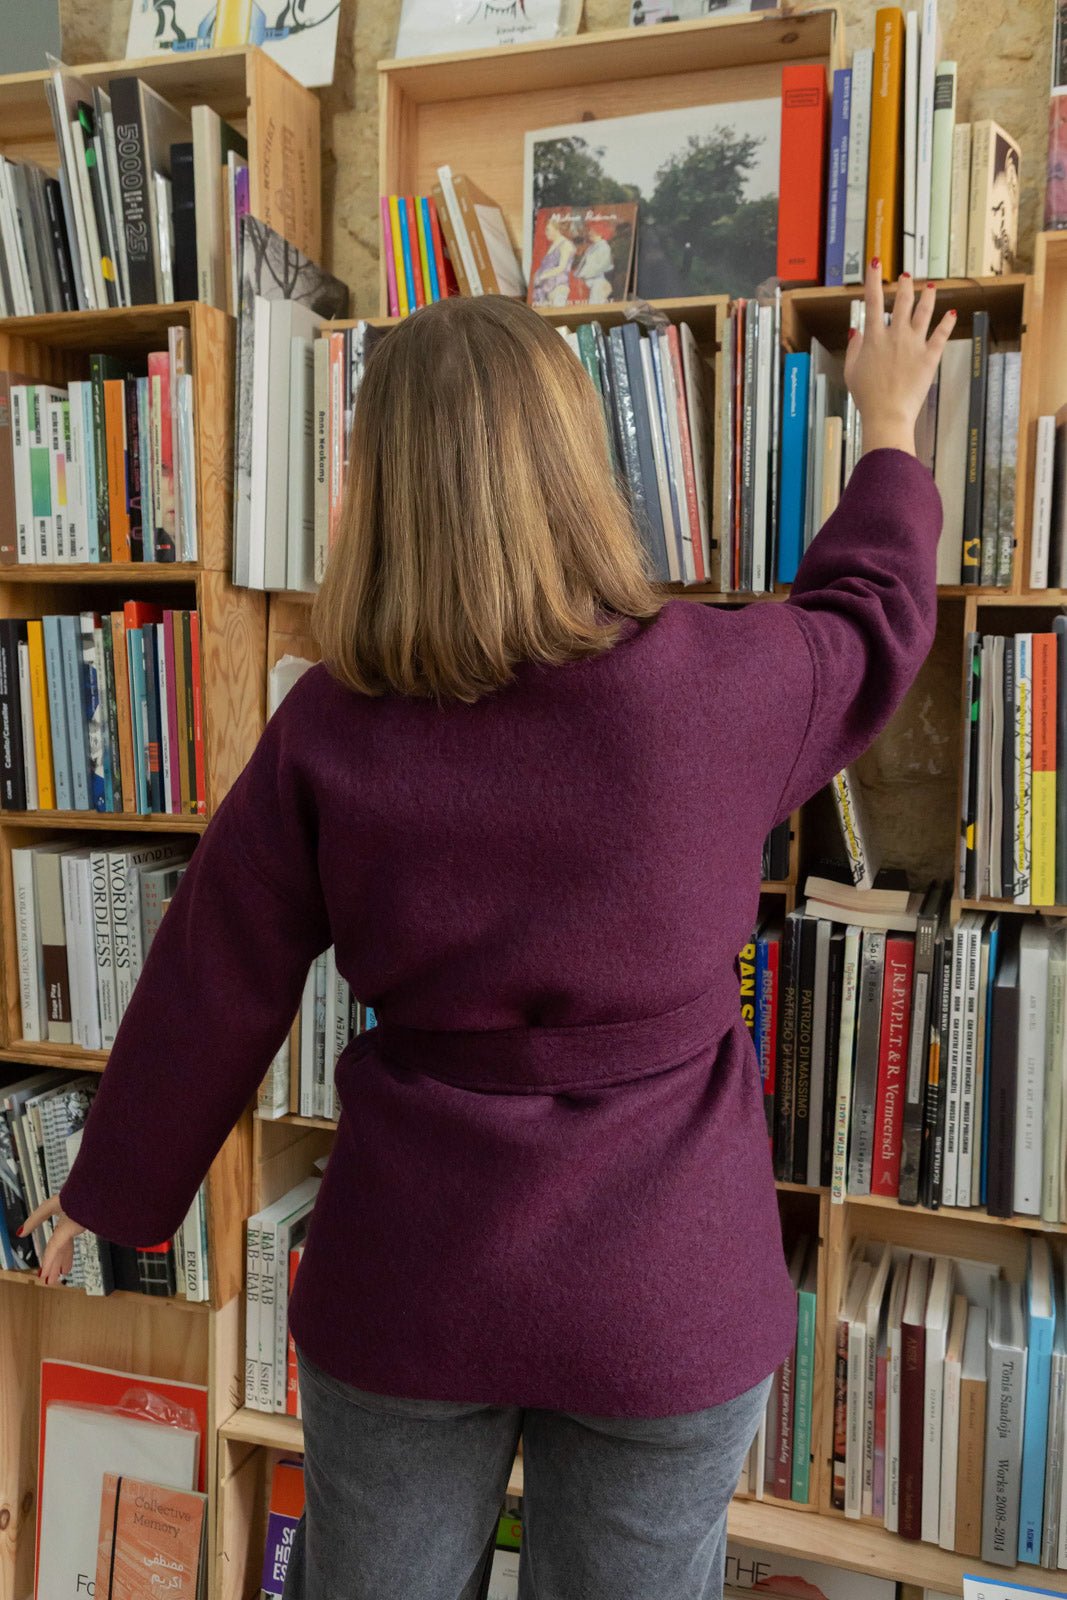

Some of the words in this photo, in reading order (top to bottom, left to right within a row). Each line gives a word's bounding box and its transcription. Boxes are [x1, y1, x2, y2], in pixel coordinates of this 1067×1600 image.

[317, 438, 326, 484] Neukamp
[92, 858, 111, 968] WORDLESS
[111, 858, 130, 968] WORDLESS
[868, 943, 879, 975] Spiral
[955, 957, 963, 990] ANDRIESSEN
[50, 984, 58, 998] Play
[763, 969, 773, 1001] ROSE
[868, 981, 876, 1002] Book
[942, 964, 950, 1012] GERSTBERGER
[51, 999, 59, 1020] Stage
[783, 986, 795, 1040] PATRIZIO
[800, 989, 812, 1043] PATRIZIO
[888, 960, 907, 1047] J.R.P.V.P.L.T.
[1029, 994, 1037, 1009] ANN
[760, 1003, 773, 1079] FINN-KELCEY
[782, 1043, 793, 1055] DI
[799, 1046, 810, 1057] DI
[952, 1030, 960, 1049] CENTRE
[966, 1031, 974, 1050] CENTRE
[887, 1065, 901, 1079] R.
[888, 1050, 900, 1062] &
[781, 1058, 793, 1116] MASSIMO
[797, 1061, 810, 1118] MASSIMO
[860, 1109, 868, 1126] Ann
[882, 1084, 899, 1160] Vermeersch
[949, 1100, 957, 1121] MOUSSE
[963, 1101, 971, 1122] MOUSSE
[948, 1122, 956, 1153] PUBLISHING
[962, 1123, 970, 1154] PUBLISHING
[187, 1251, 197, 1292] ERIZO
[259, 1231, 275, 1305] RAB-RAB
[246, 1358, 259, 1392] Issue
[260, 1361, 273, 1395] Issue
[1001, 1361, 1015, 1391] Tõnis
[260, 1397, 272, 1406] 5
[997, 1393, 1013, 1439] Saadoja
[996, 1459, 1009, 1493] Works
[135, 1496, 192, 1522] Collective
[133, 1512, 181, 1539] Memory
[724, 1556, 772, 1588] THE
